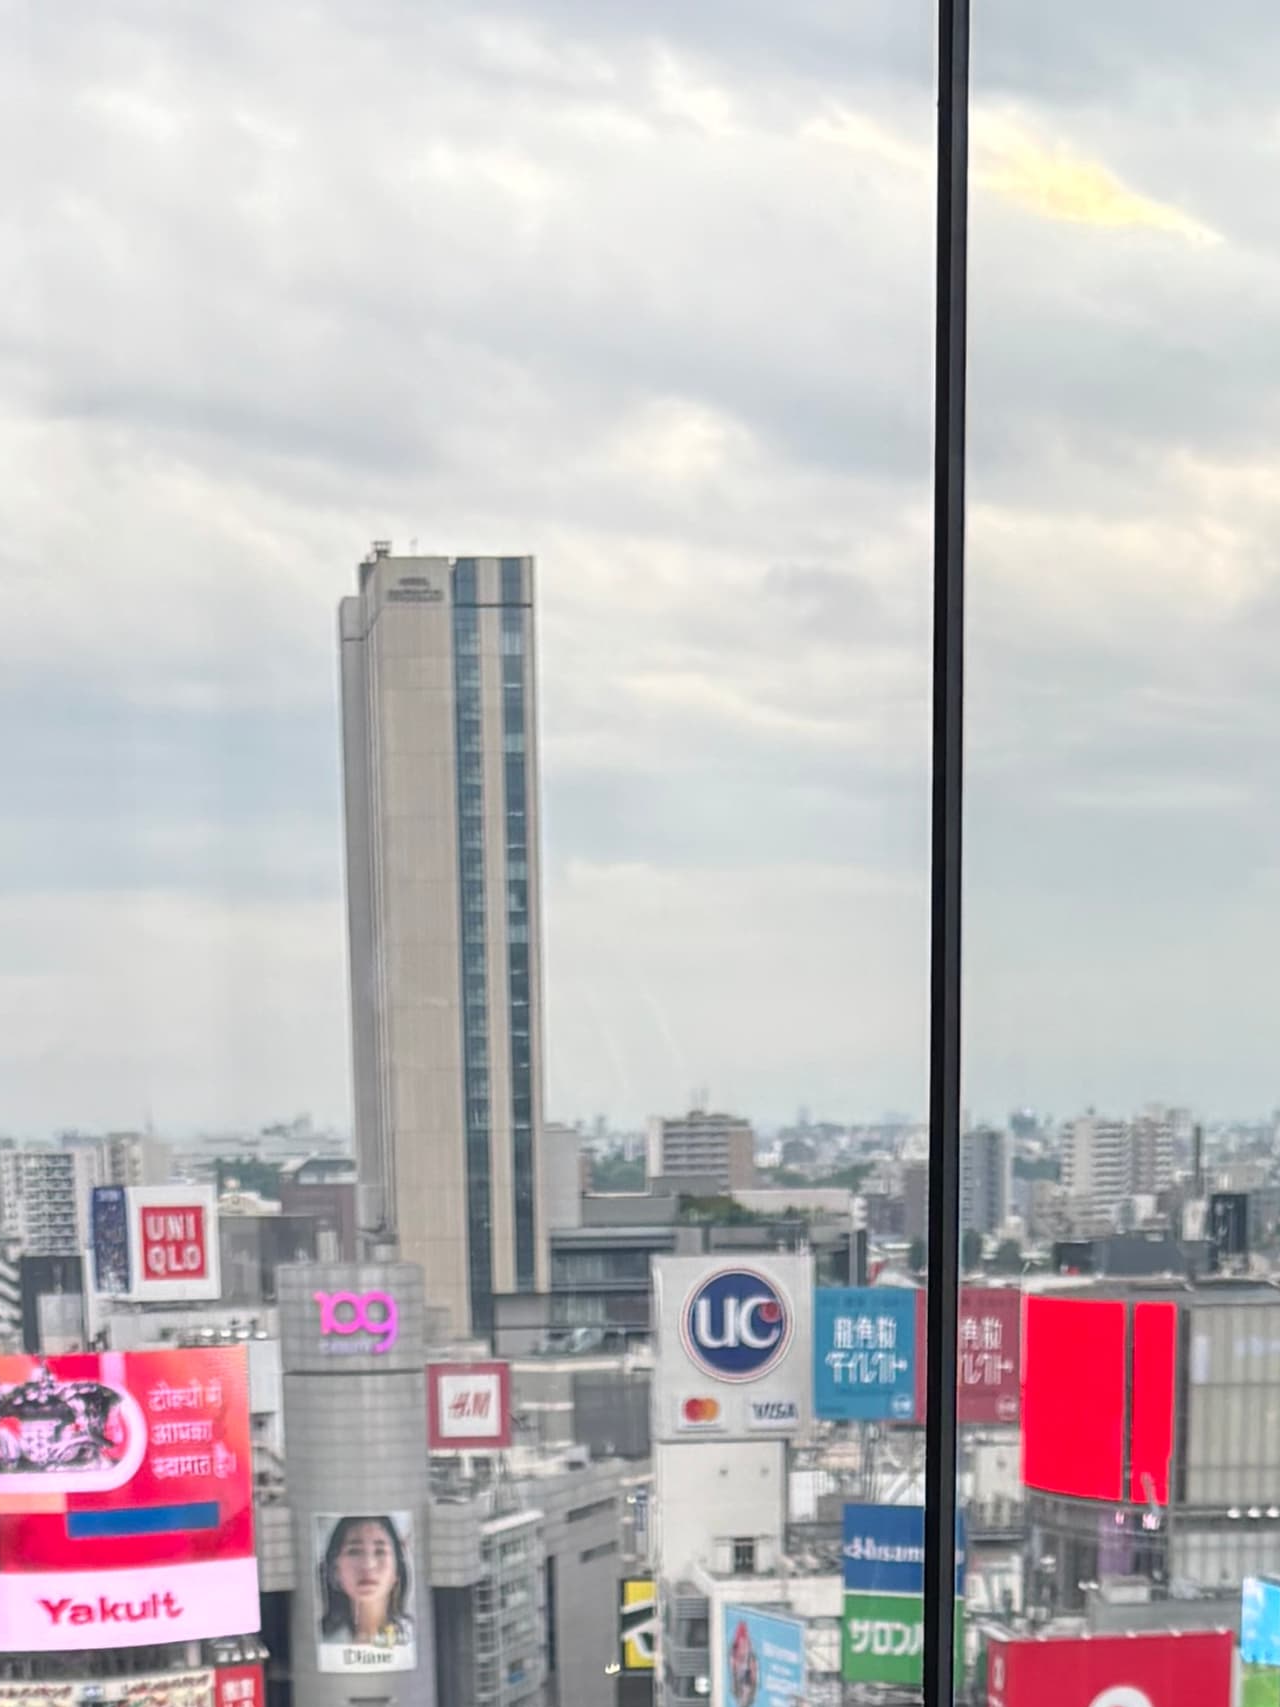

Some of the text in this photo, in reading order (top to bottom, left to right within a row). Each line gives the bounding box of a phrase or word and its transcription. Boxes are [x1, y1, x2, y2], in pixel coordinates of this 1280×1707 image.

[146, 1213, 196, 1241] UNI
[148, 1245, 201, 1275] QLO
[312, 1290, 399, 1354] 109
[448, 1391, 491, 1419] H&M
[753, 1402, 798, 1420] VISA
[39, 1592, 184, 1625] Yakult
